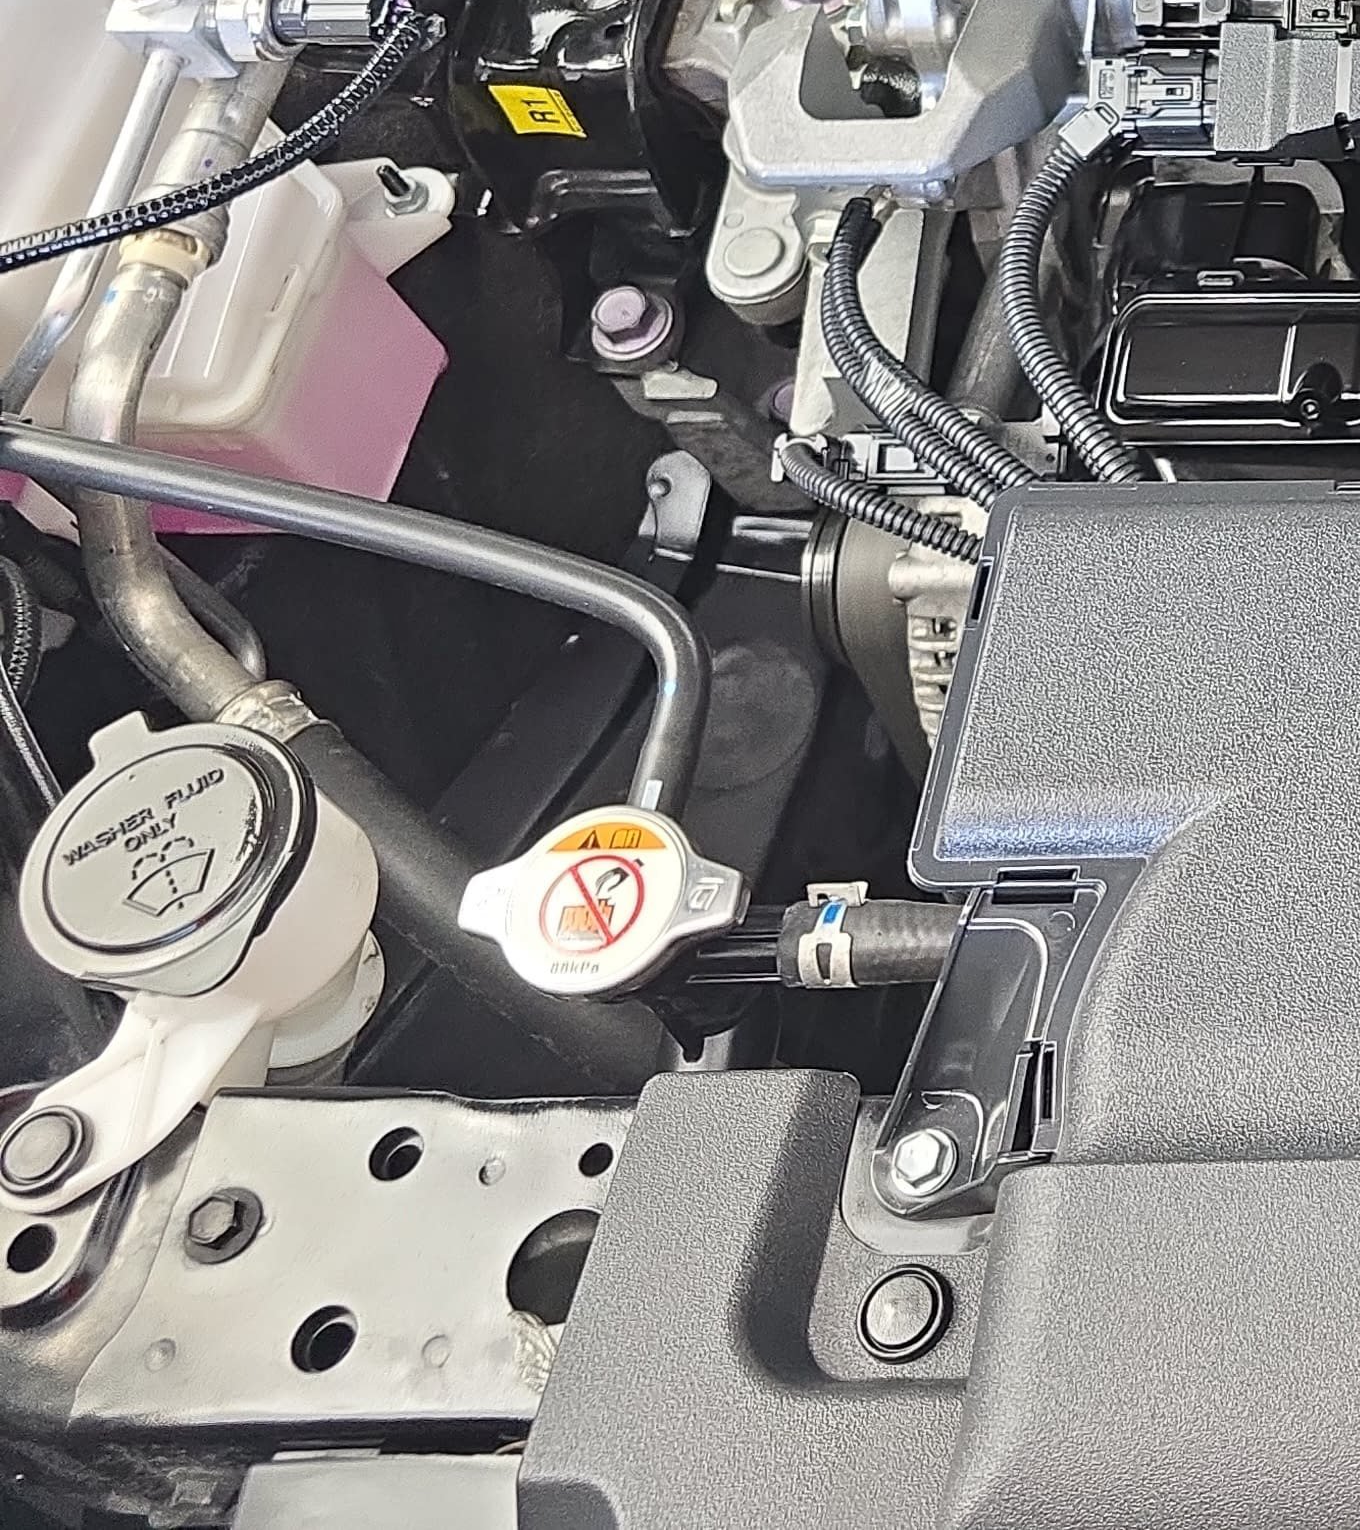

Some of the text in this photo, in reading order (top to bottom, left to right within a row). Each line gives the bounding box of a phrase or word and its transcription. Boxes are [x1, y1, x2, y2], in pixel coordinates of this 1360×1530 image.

[520, 99, 560, 124] R1
[62, 768, 226, 866] WASHER FLUID
[123, 812, 178, 853] ONLY
